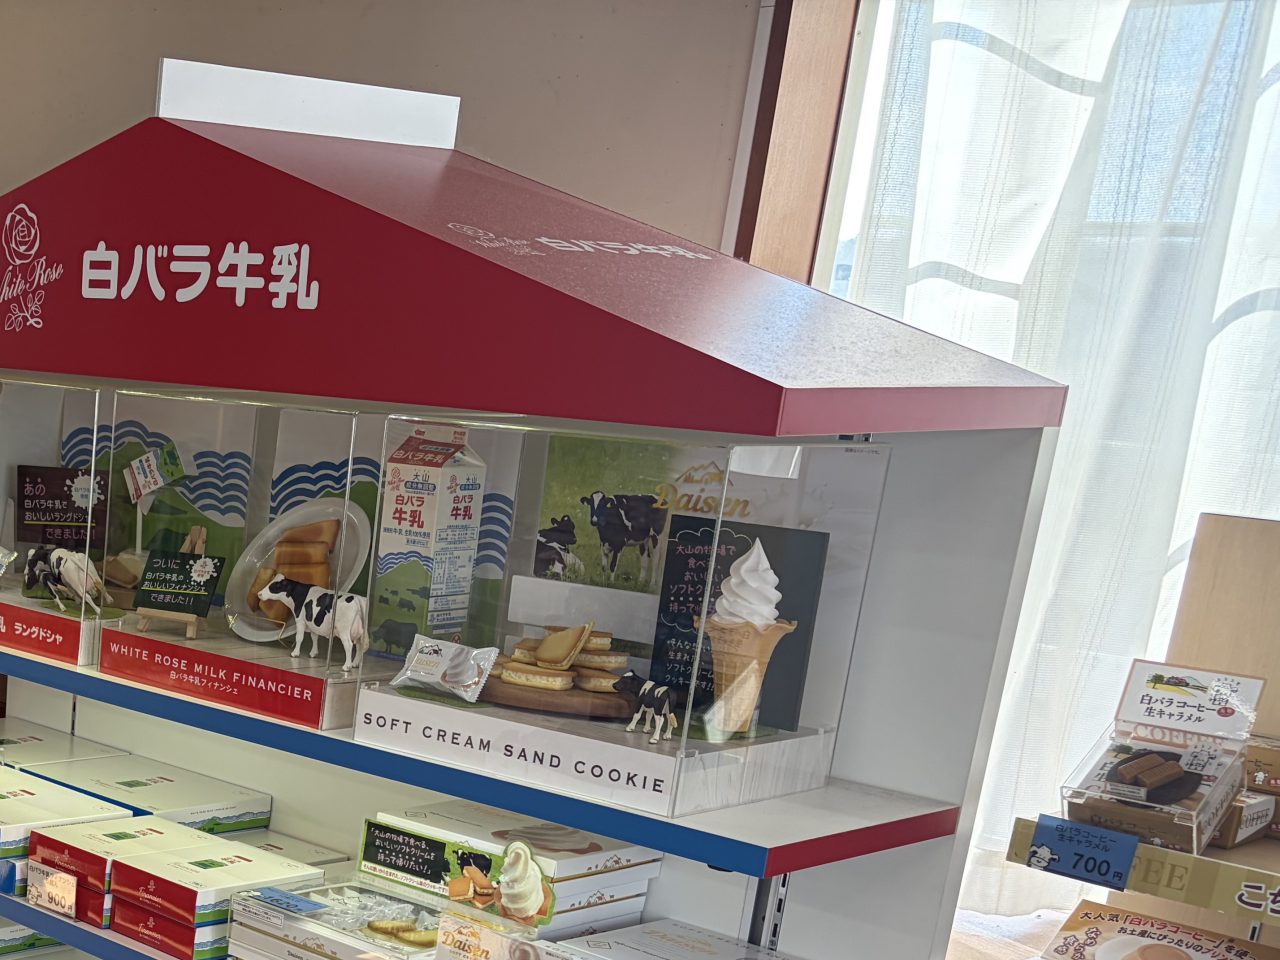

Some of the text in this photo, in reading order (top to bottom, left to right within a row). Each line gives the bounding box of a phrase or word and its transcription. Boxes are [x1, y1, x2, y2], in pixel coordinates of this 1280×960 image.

[26, 255, 64, 292] Rose
[81, 240, 319, 310] 白バラ牛乳
[392, 449, 445, 464] 白バラ牛乳
[412, 472, 430, 482] 大山
[24, 483, 46, 496] あの
[452, 494, 474, 504] 白バラ
[24, 500, 68, 509] 白バラ牛乳で
[395, 494, 425, 507] 白バラ
[653, 482, 751, 518] Daisen
[392, 507, 425, 529] 牛乳
[450, 506, 473, 521] 牛乳
[153, 558, 180, 569] ついに
[142, 581, 207, 593] おいしいフィナンシェ
[145, 572, 184, 582] 白バラ牛乳の
[150, 593, 193, 605] できました!!
[14, 623, 63, 645] ラングドシャ
[110, 642, 312, 701] WHITE ROSE MILK FINANCIER
[169, 671, 238, 695] 白バラ牛乳フィナンシェ
[1144, 705, 1205, 724] 生キャラメル
[363, 712, 664, 794] SOFT CREAM SAND COOKIE
[1055, 822, 1118, 846] 白バラコーヒー
[1057, 833, 1111, 853] 生キャラメル
[375, 840, 436, 861] おいしいソフトクリームを
[1069, 851, 1124, 882] 700円
[441, 930, 491, 960] Daisen
